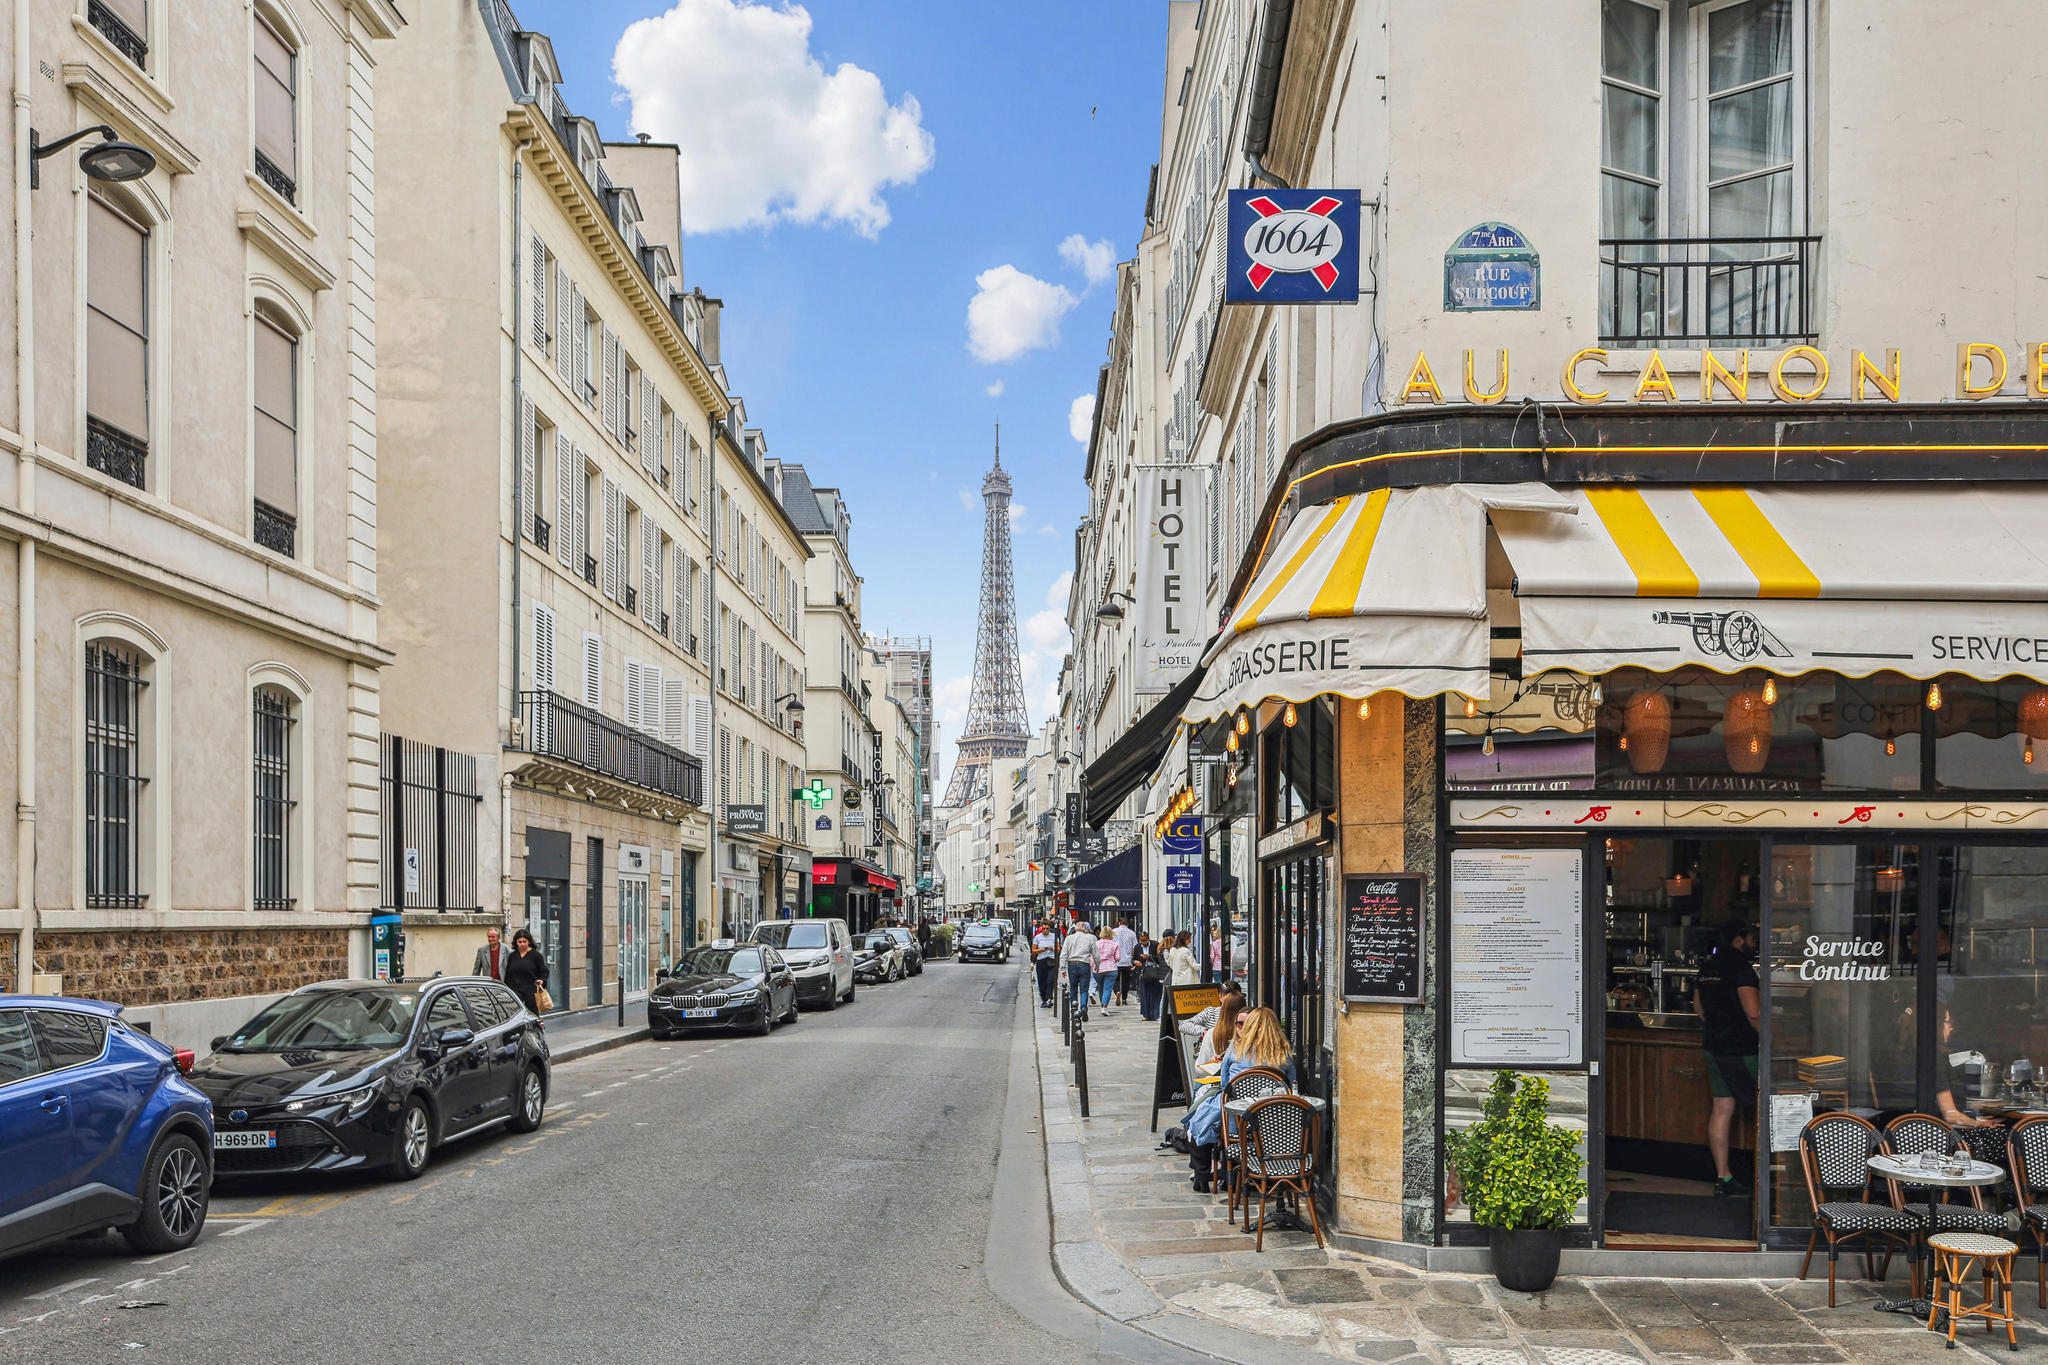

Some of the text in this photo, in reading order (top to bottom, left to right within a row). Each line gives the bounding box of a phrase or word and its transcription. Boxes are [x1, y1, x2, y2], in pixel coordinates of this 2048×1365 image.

[1254, 219, 1331, 257] 1664
[1475, 267, 1511, 281] RUE
[1455, 286, 1530, 300] SURCOUF
[1396, 348, 1509, 405] AU
[1560, 345, 1901, 404] CANON
[1159, 478, 1184, 635] HOTEL
[1140, 637, 1202, 649] Le Pavillon
[1931, 635, 2048, 663] SERVICE
[1158, 656, 1192, 665] HOTEL
[1228, 639, 1350, 690] BRASSERIE
[873, 733, 882, 844] THOUMIEUX
[729, 811, 765, 820] PROVOST
[1166, 824, 1202, 838] LCL
[1803, 935, 1885, 957] Service
[1799, 959, 1891, 981] Continu
[1184, 991, 1206, 999] CANON
